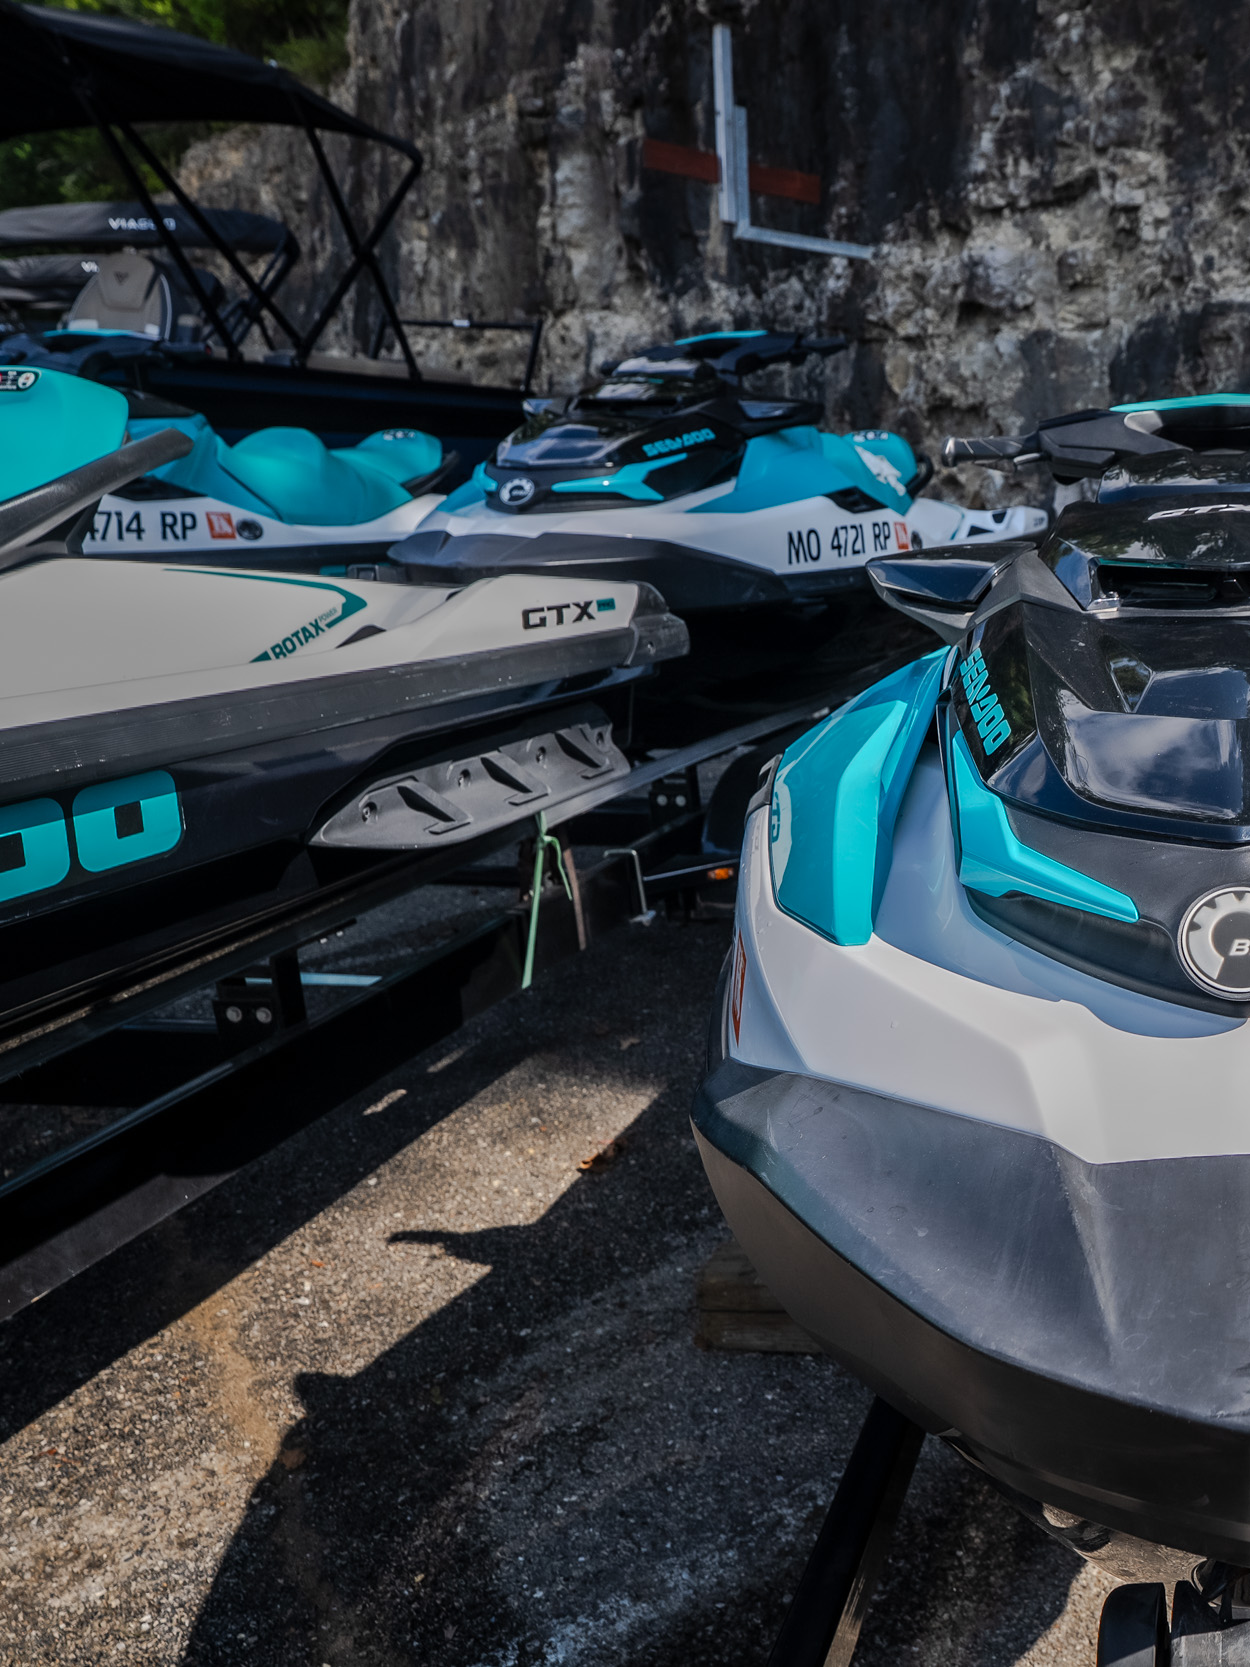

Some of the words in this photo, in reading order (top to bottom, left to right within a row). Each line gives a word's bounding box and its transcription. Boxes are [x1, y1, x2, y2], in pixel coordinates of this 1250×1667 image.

[160, 511, 198, 541] RP
[787, 529, 821, 566] MO
[831, 524, 866, 555] 4721
[872, 522, 891, 551] RP
[522, 600, 596, 629] GTX
[270, 618, 325, 660] ROTAX
